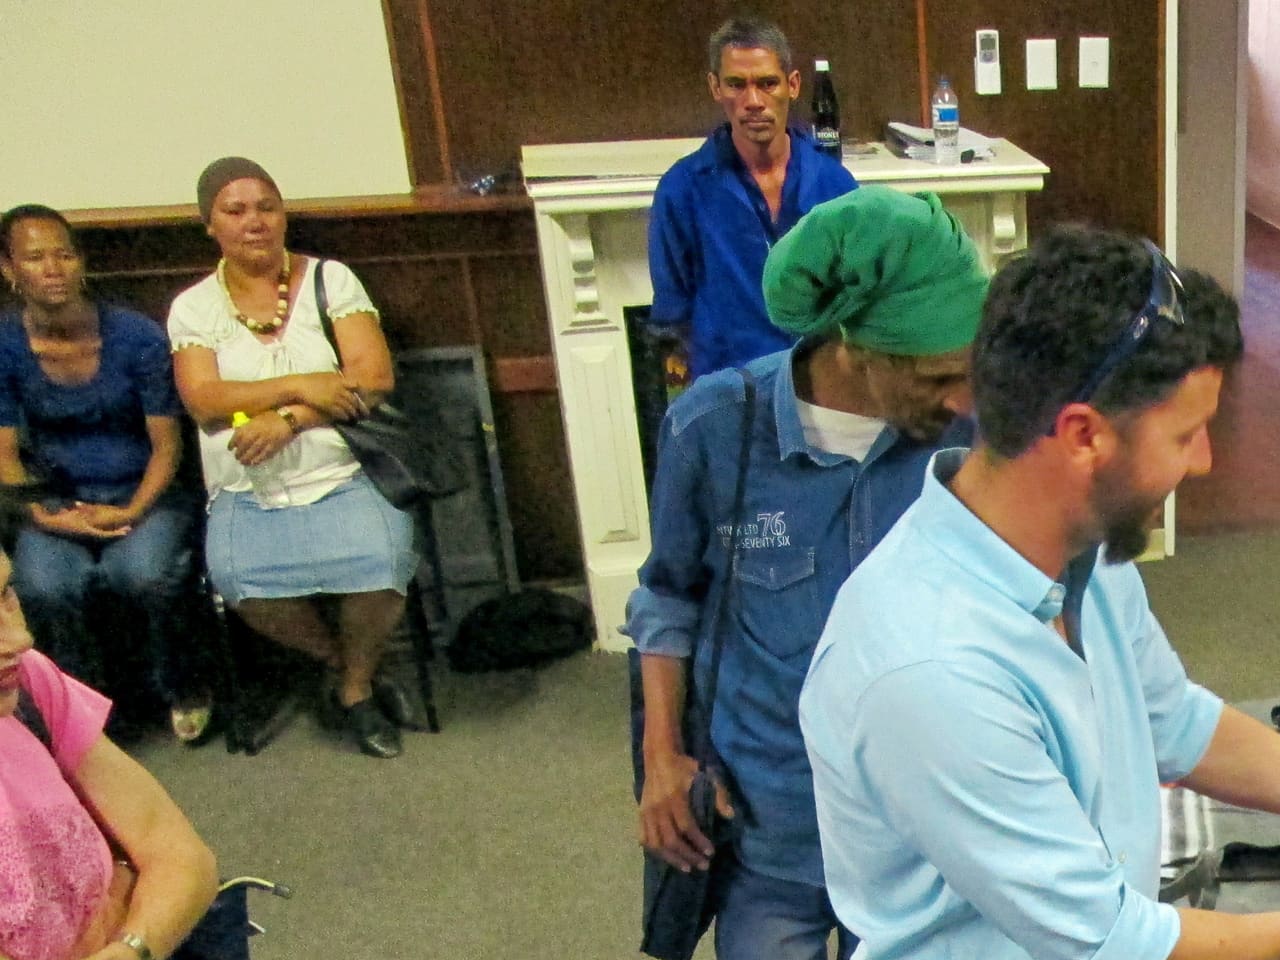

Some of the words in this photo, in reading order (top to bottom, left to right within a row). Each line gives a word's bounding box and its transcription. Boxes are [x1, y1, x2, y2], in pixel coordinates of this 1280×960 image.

[756, 511, 786, 536] 76
[742, 537, 775, 549] SEVENTY
[778, 535, 791, 547] SIX
